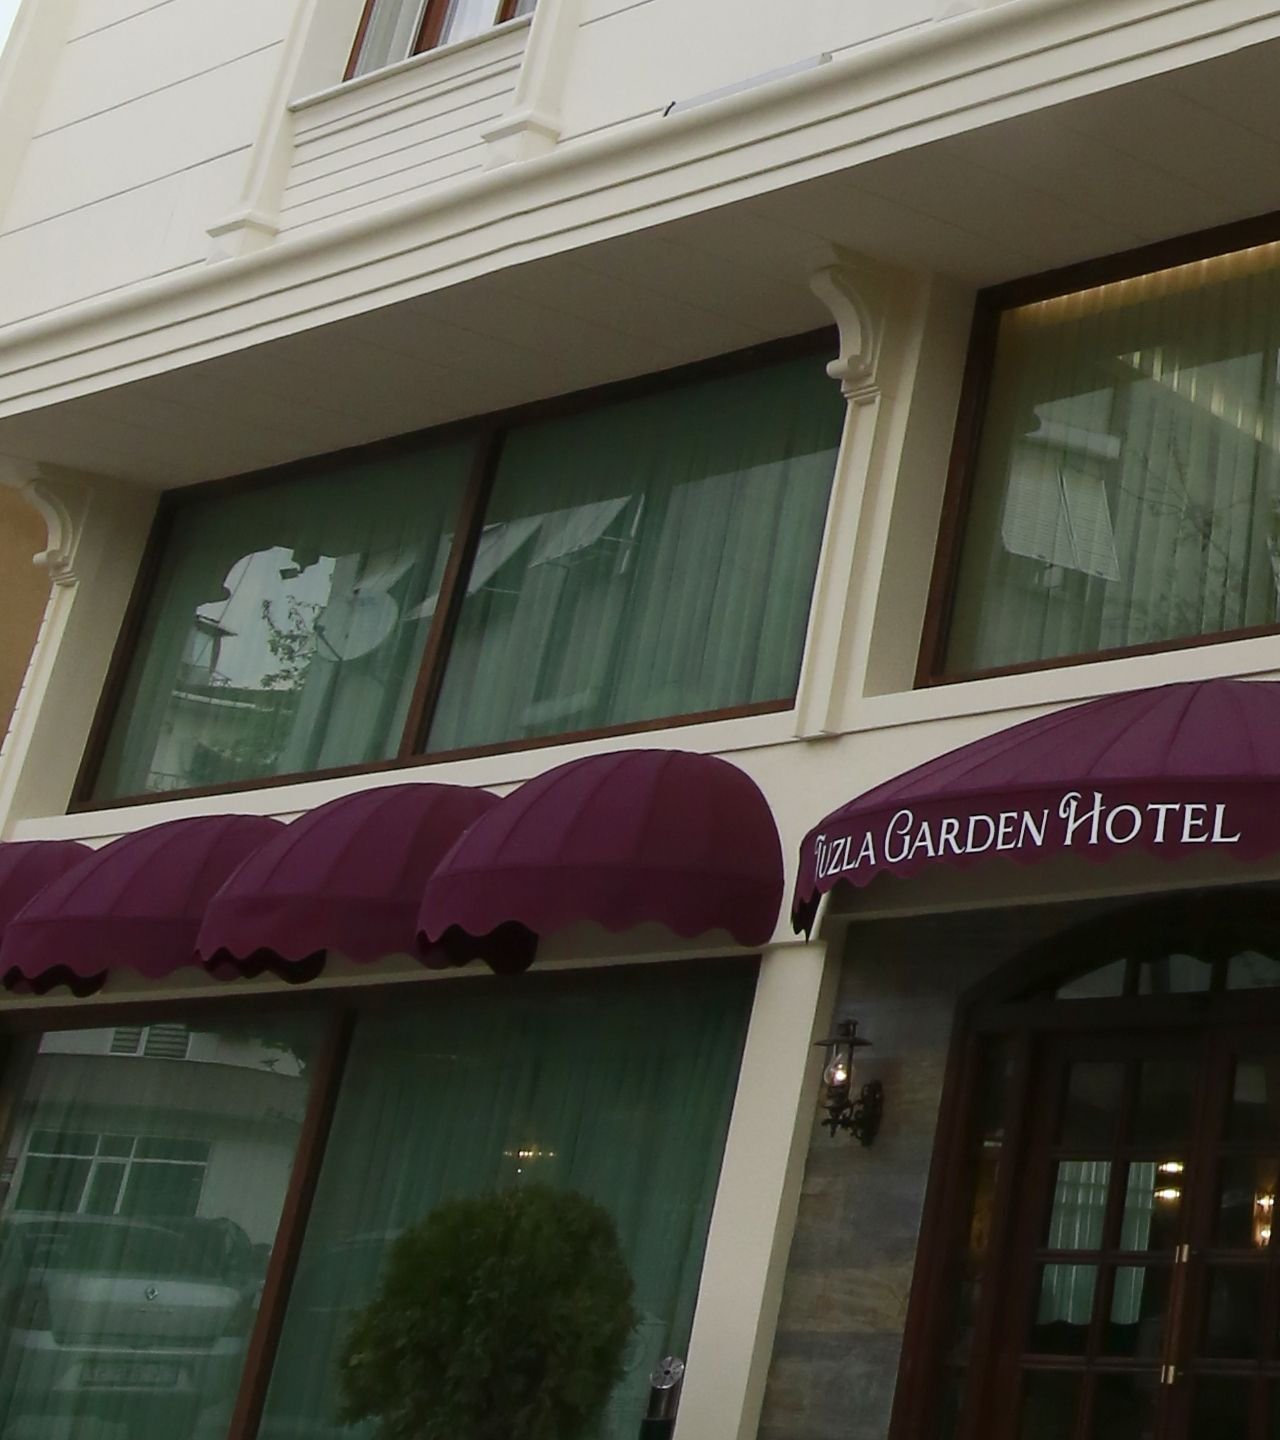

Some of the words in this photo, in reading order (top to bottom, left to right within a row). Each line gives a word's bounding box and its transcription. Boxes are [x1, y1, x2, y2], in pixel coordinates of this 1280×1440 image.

[814, 831, 877, 879] TUZLA
[884, 809, 1048, 863] GARDEN
[1058, 791, 1241, 845] HOTEL
